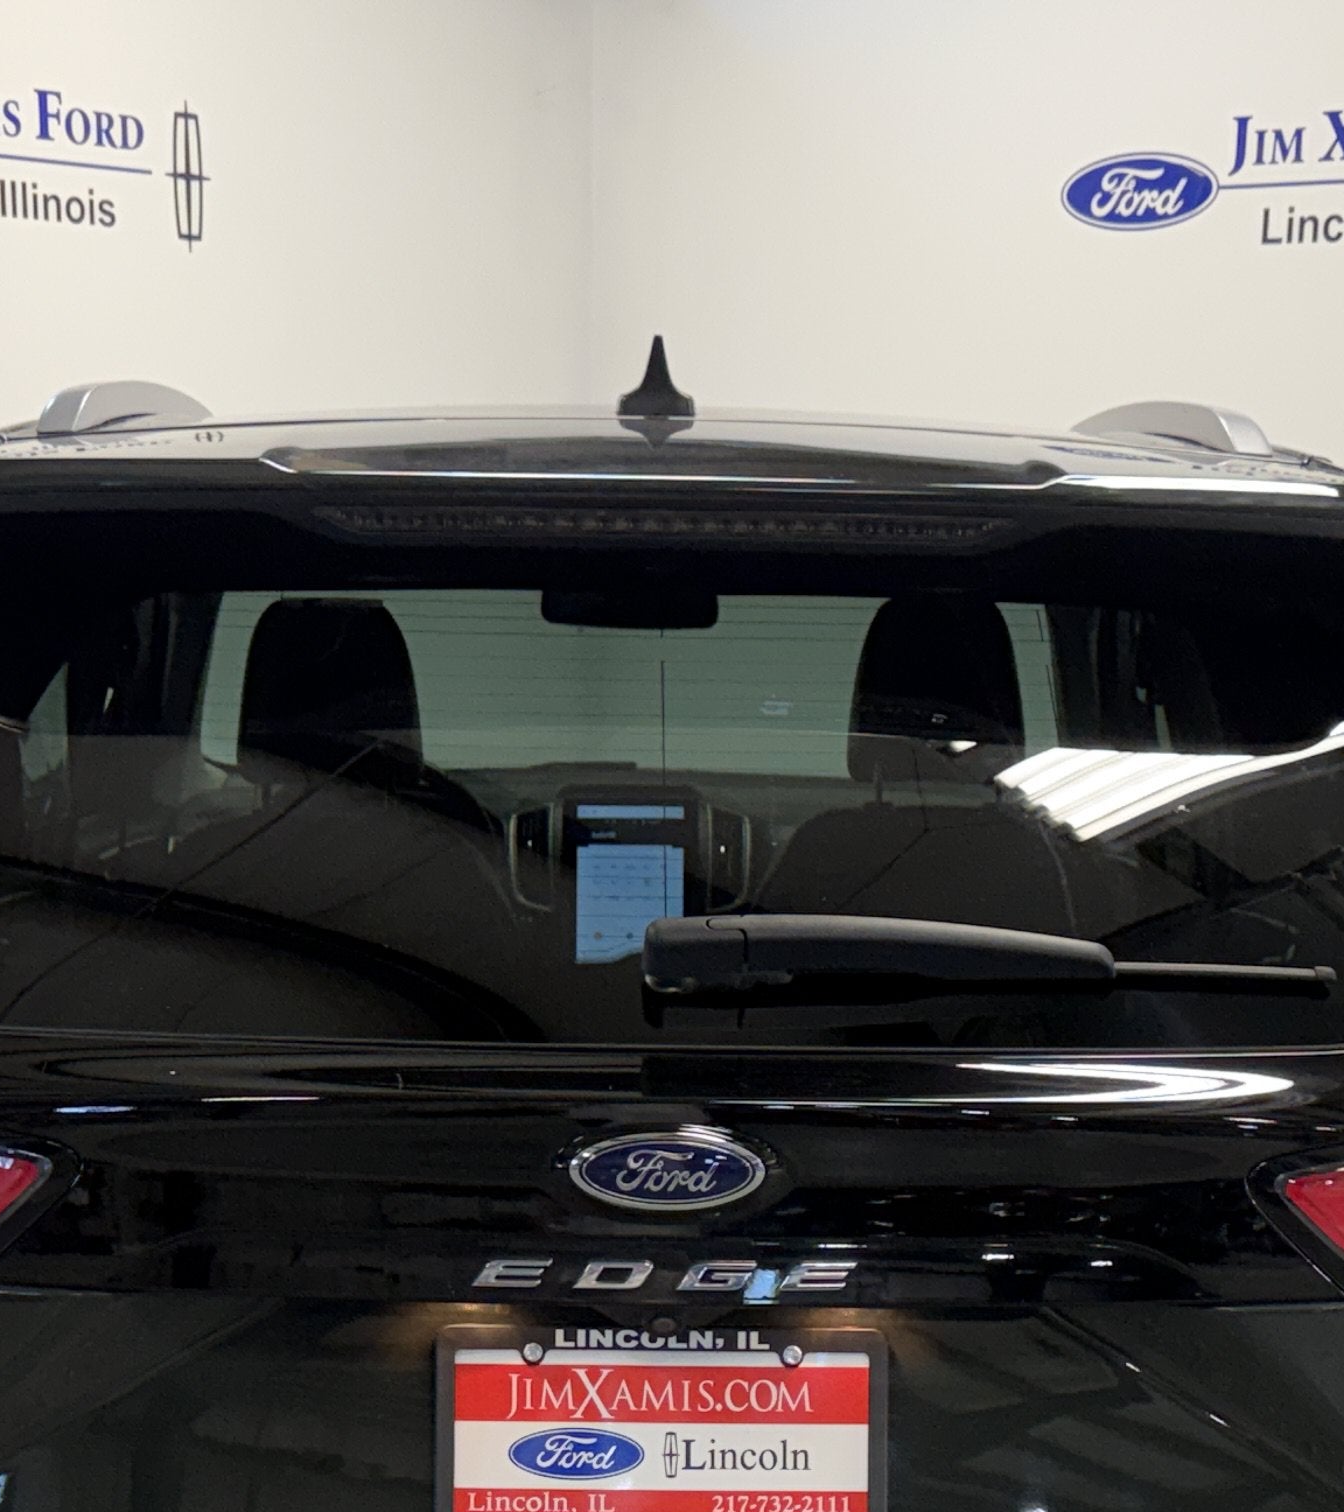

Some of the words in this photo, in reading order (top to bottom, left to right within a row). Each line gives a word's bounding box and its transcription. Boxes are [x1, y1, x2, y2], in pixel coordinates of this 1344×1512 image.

[34, 88, 144, 150] FORD
[1228, 115, 1306, 177] JIM
[0, 179, 116, 228] Illinois
[1091, 167, 1183, 217] Ford
[616, 1150, 717, 1192] Ford
[471, 1258, 857, 1291] EDGE
[737, 1331, 770, 1349] IL
[507, 1368, 813, 1420] JIMXAMIS.COM
[536, 1436, 615, 1470] Ford
[682, 1439, 811, 1471] Lincoln
[588, 1494, 615, 1512] IL
